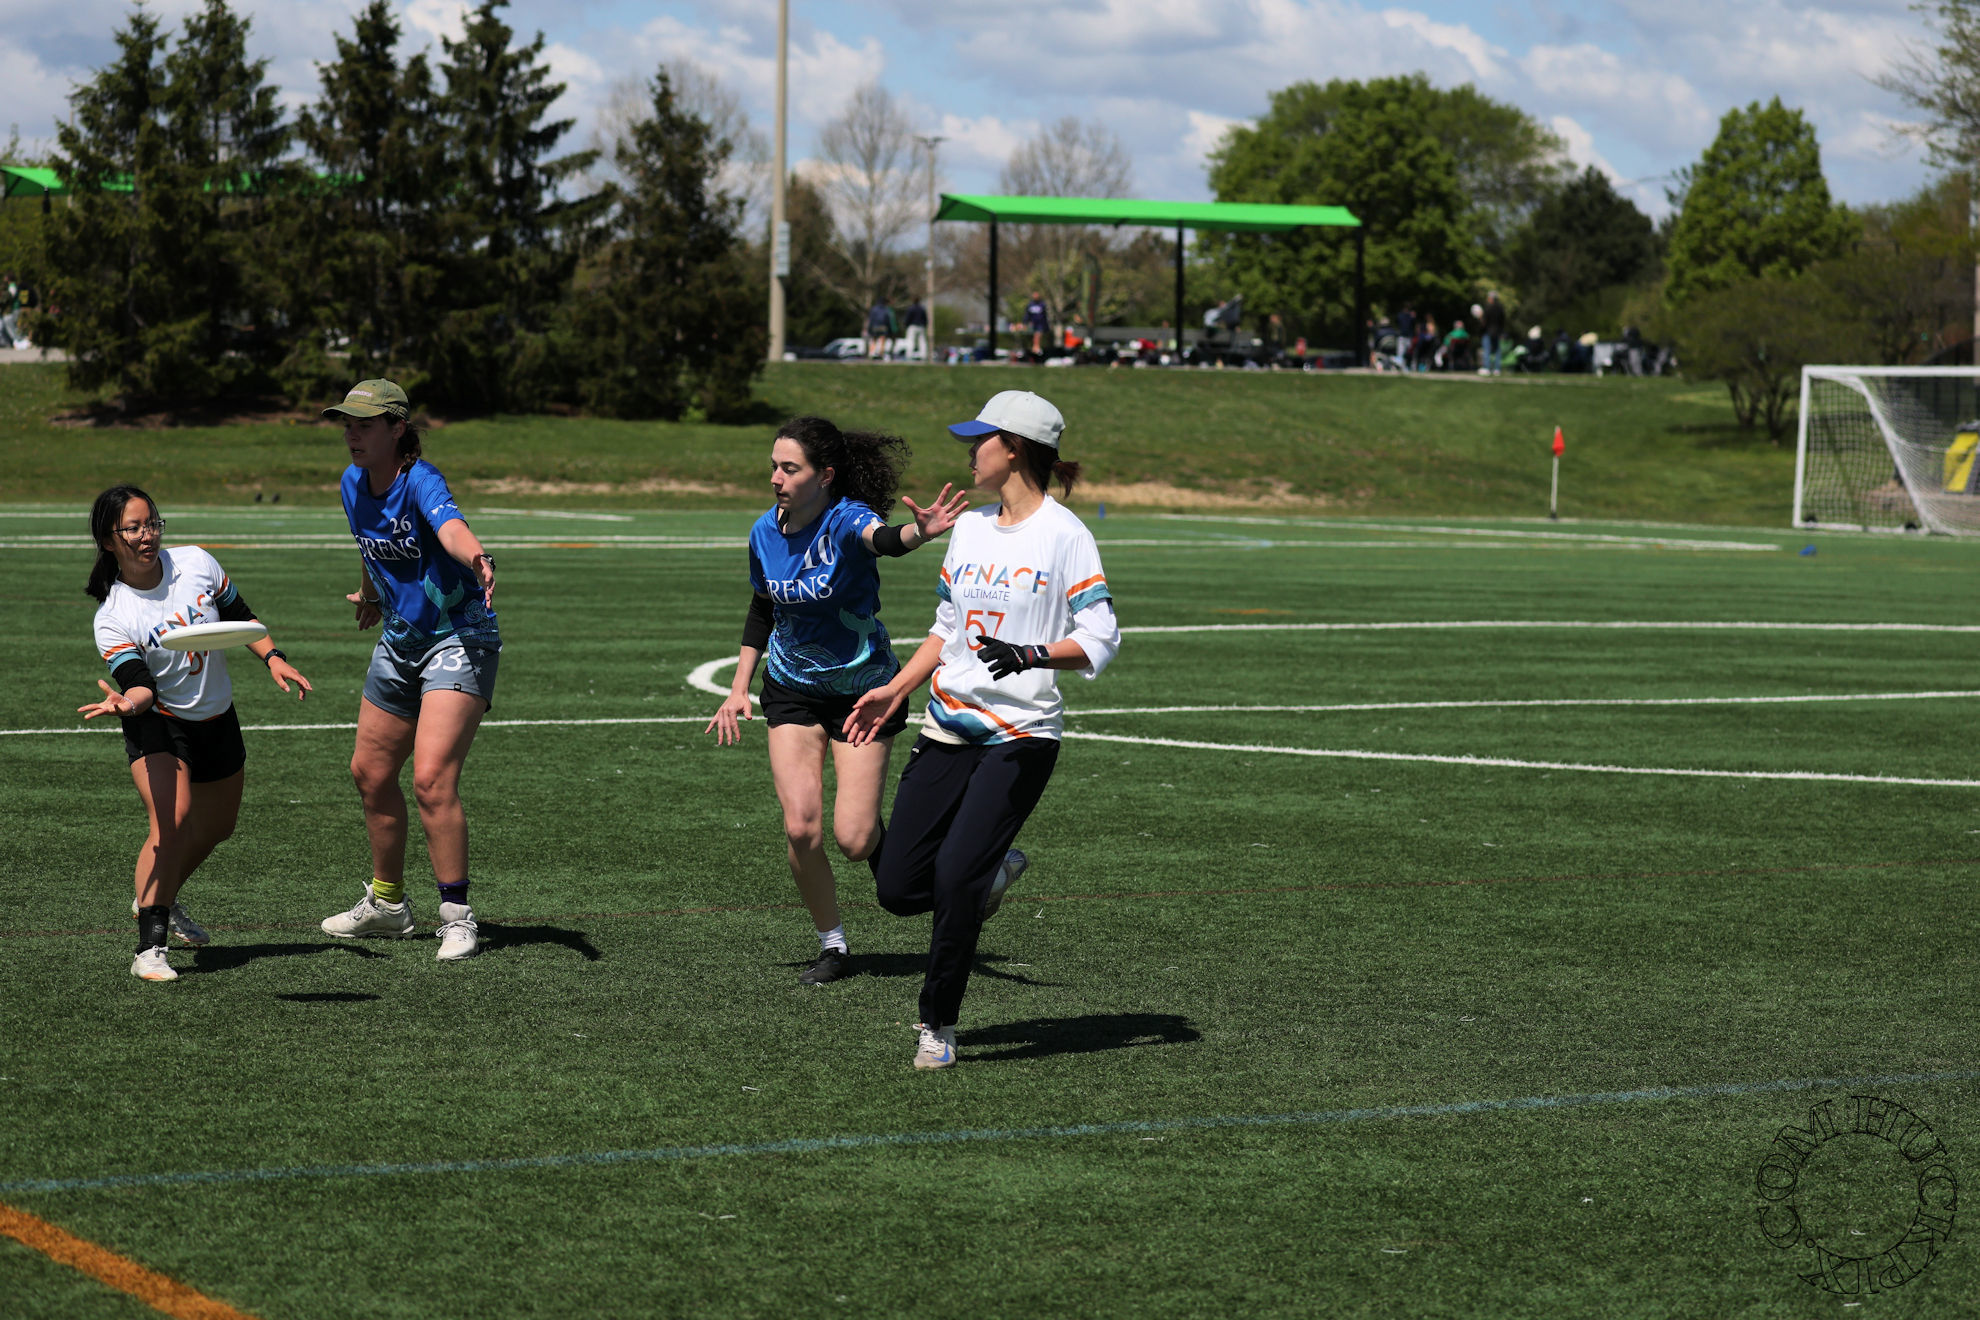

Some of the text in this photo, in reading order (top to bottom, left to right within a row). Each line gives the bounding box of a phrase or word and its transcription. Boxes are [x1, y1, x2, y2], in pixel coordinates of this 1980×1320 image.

[390, 514, 412, 534] 26
[801, 534, 834, 571] 10
[764, 573, 833, 605] RENS
[963, 587, 1010, 602] ULTIMATE
[965, 609, 1006, 651] 57
